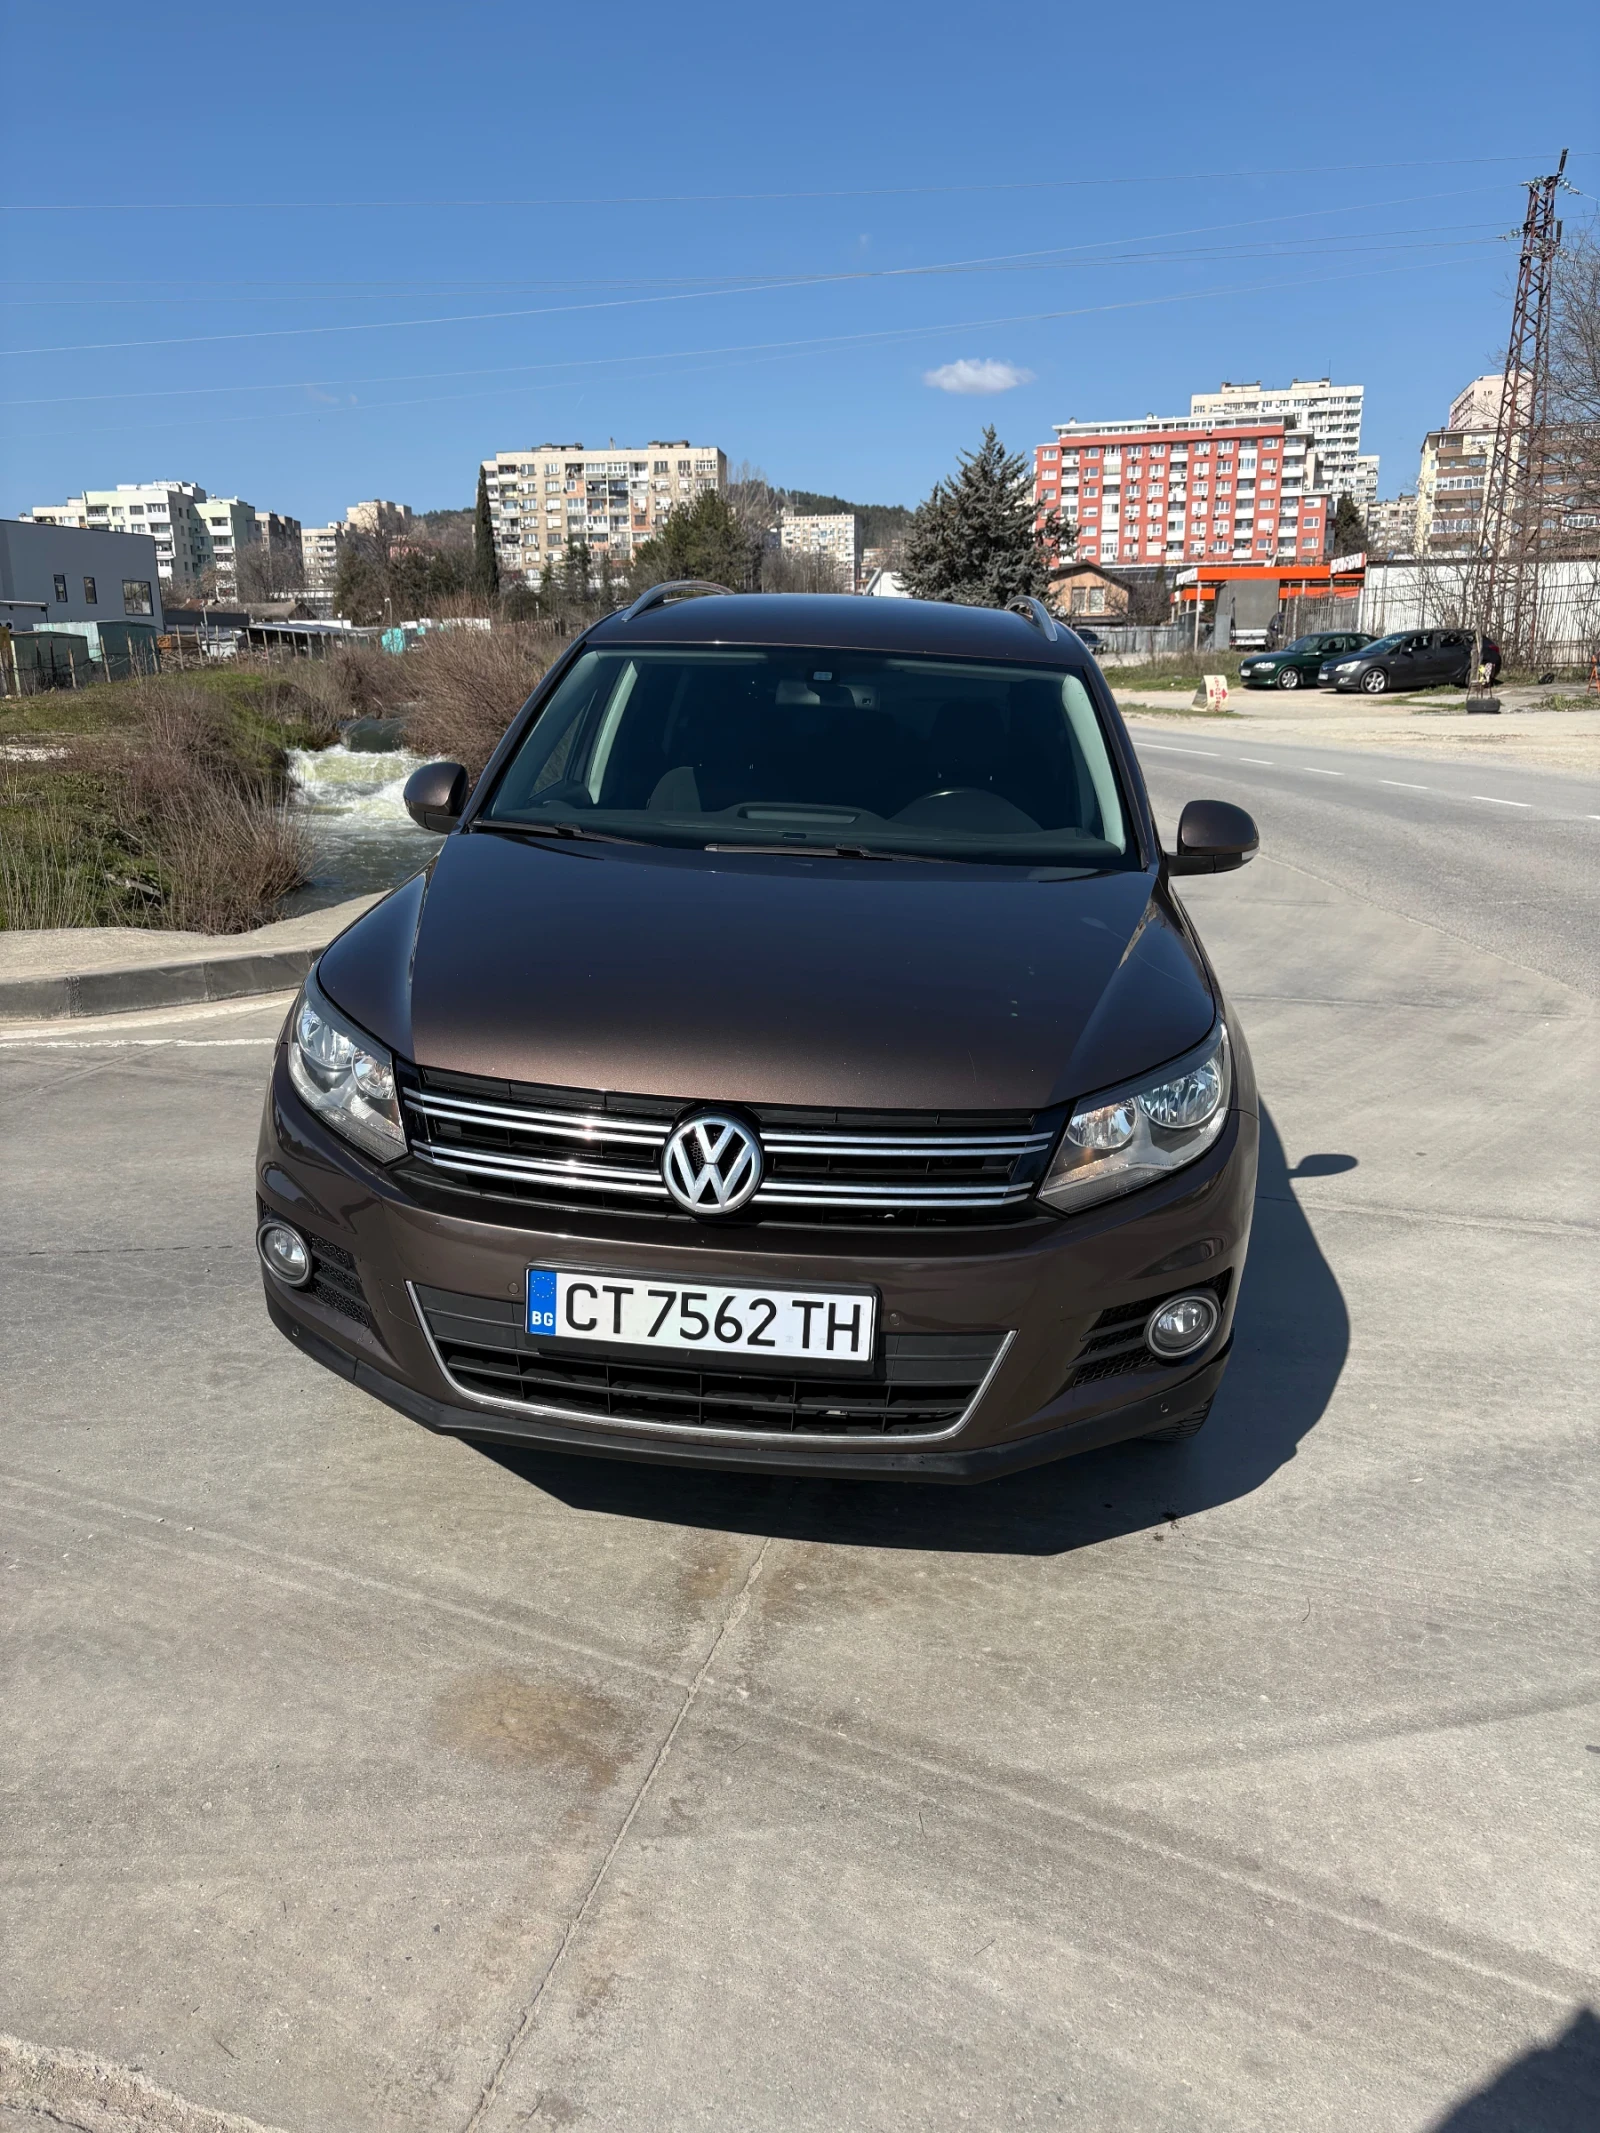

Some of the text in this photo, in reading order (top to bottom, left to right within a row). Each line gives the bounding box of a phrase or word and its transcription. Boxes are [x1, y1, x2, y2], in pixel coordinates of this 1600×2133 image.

[531, 1310, 554, 1327] BG
[565, 1283, 861, 1352] CT 7562 TH
